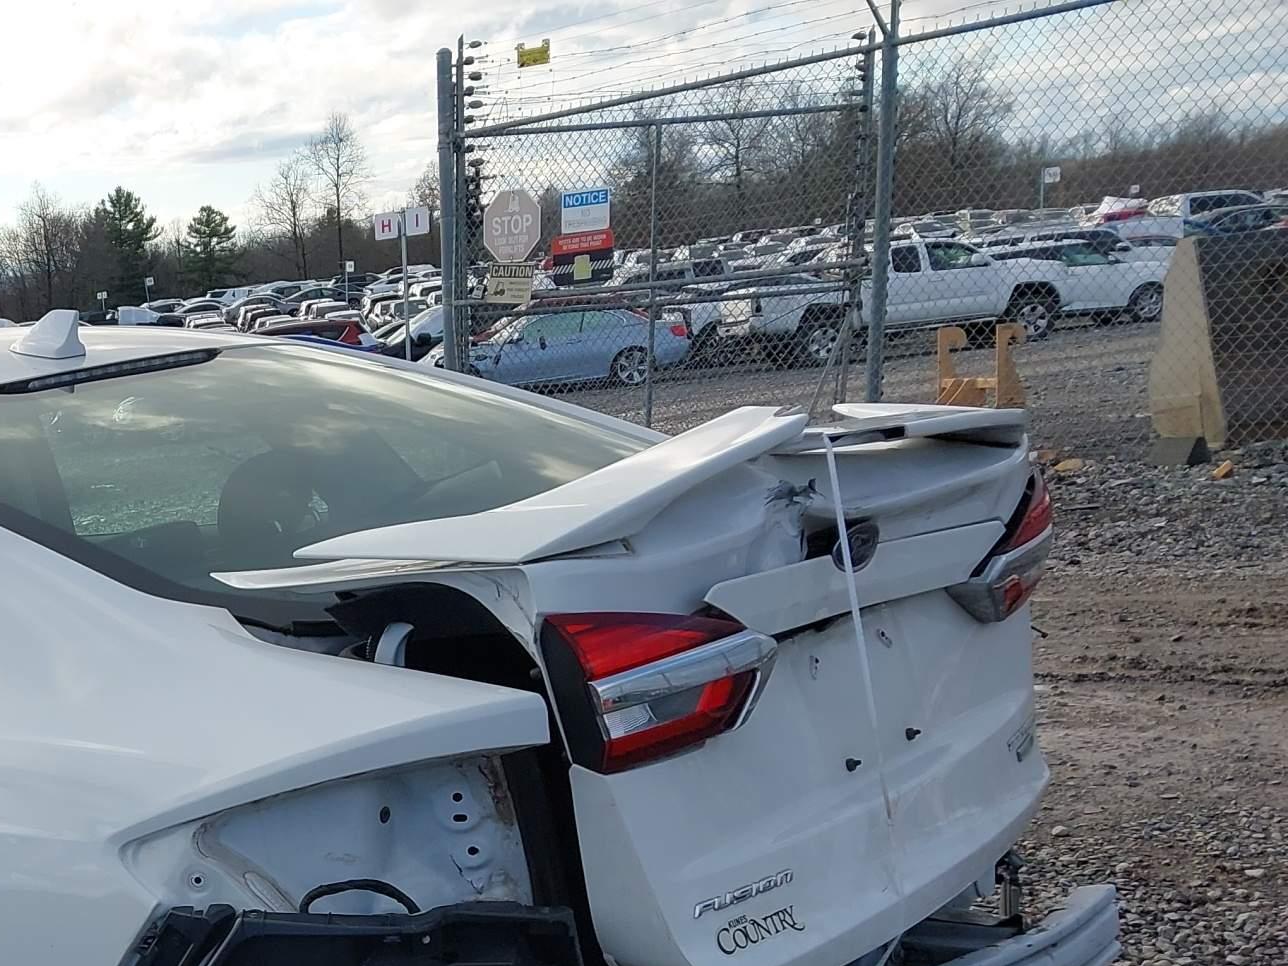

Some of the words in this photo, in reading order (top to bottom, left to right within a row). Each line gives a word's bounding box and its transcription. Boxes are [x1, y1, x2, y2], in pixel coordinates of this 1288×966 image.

[565, 191, 607, 207] NOTICE
[381, 218, 392, 233] H
[492, 214, 532, 236] STOP
[492, 265, 533, 277] CAUTION
[716, 905, 806, 955] COUNTRY
